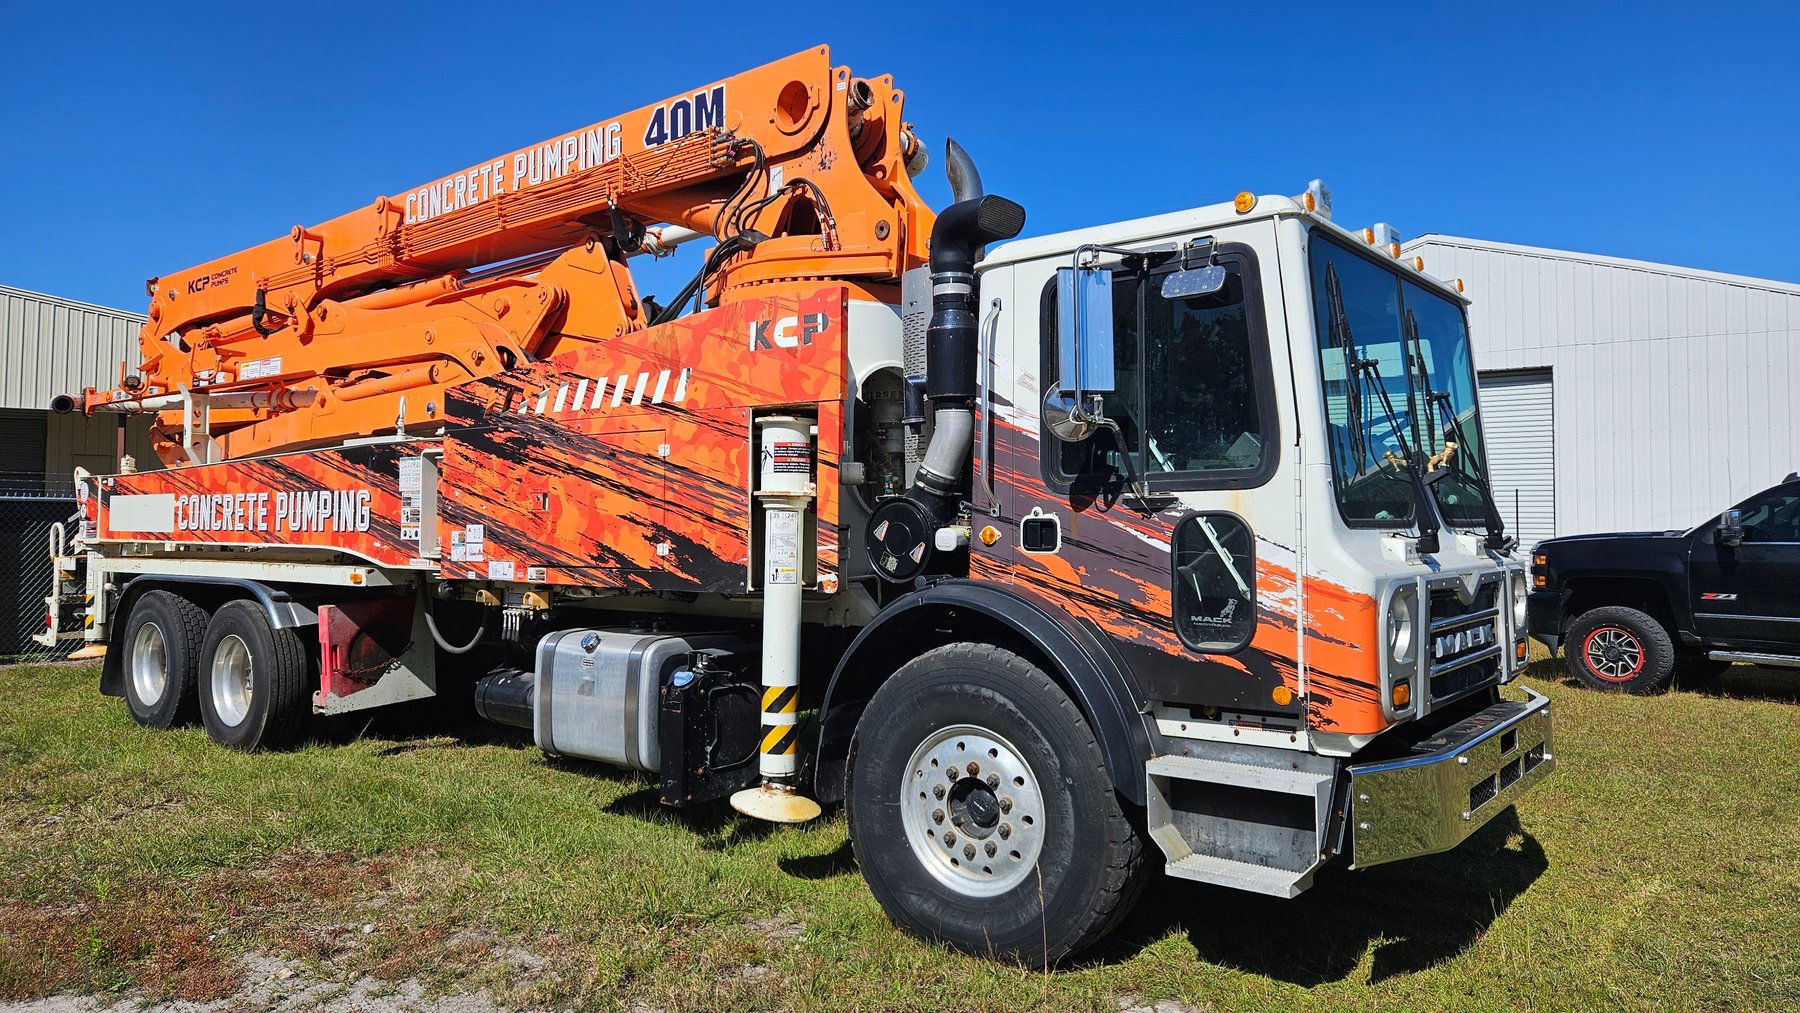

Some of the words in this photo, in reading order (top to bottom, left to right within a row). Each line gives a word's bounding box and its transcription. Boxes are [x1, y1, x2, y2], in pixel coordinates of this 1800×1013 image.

[643, 83, 726, 148] 40M
[405, 160, 505, 225] CONCRETE
[513, 121, 622, 191] PUMPING
[188, 275, 210, 295] KCP
[211, 267, 238, 280] CONCRETE
[211, 277, 229, 288] PUMPS
[749, 312, 829, 352] KCP
[177, 493, 270, 531] CONCRETE
[275, 489, 371, 532] PUMPING
[1191, 615, 1233, 624] MACK
[1435, 623, 1494, 658] MACK
